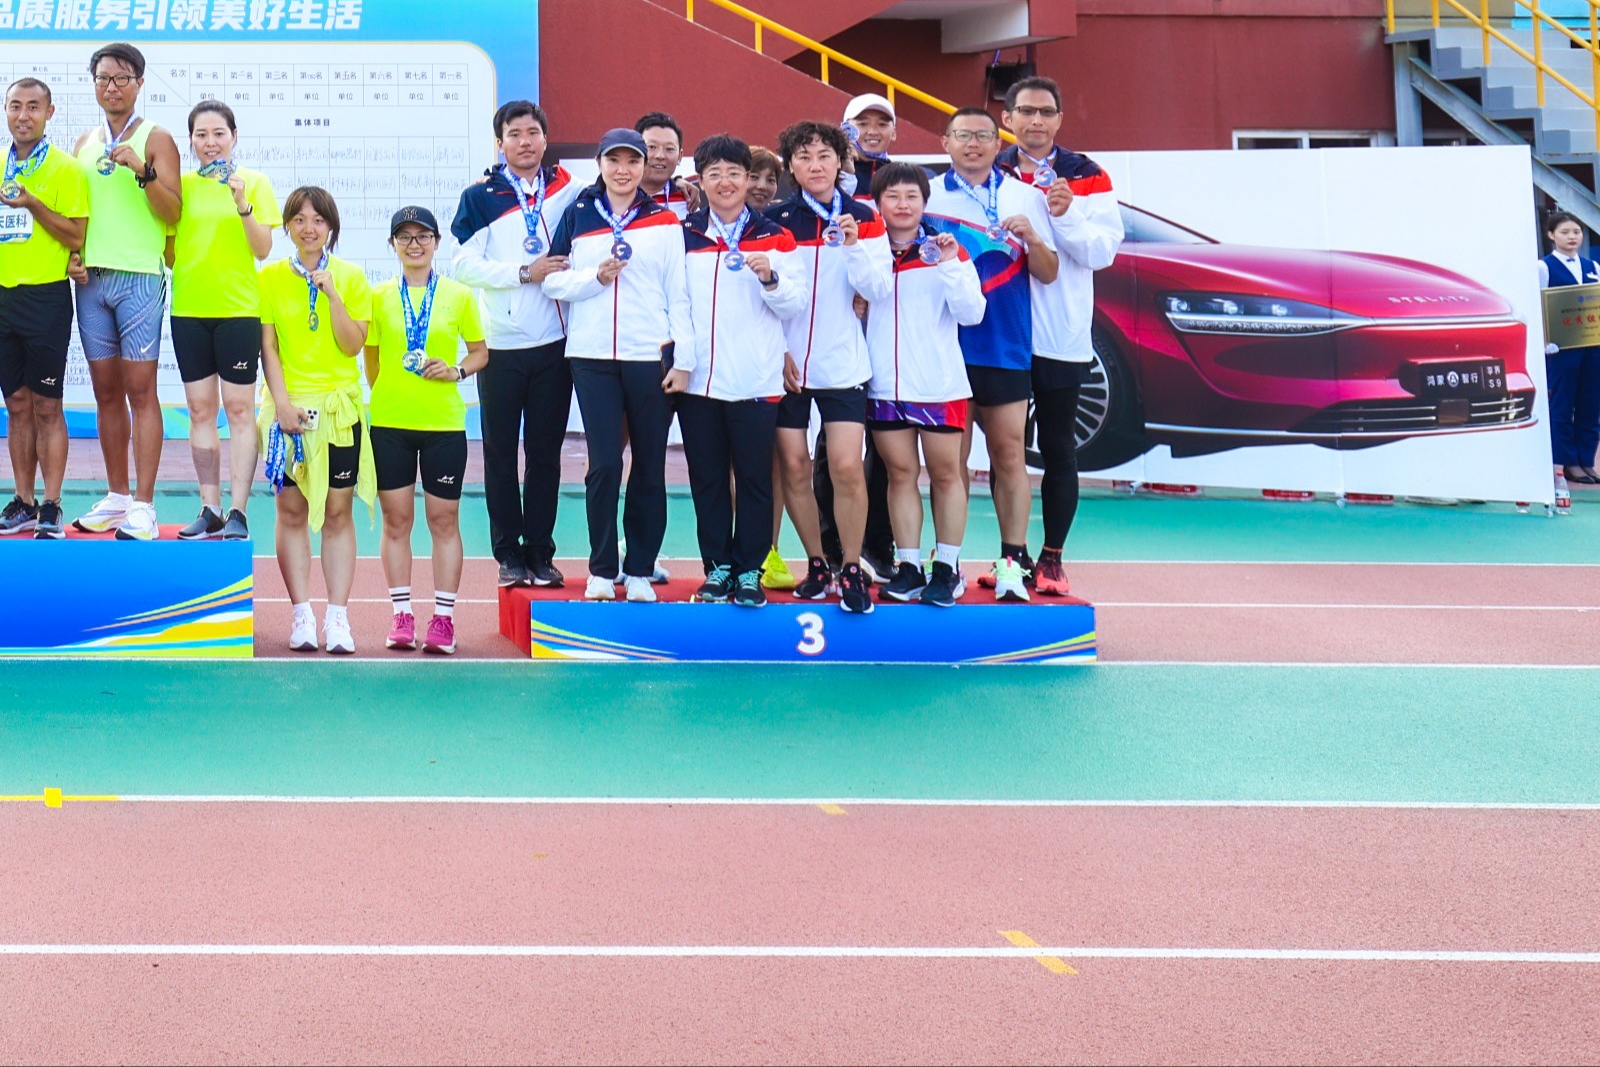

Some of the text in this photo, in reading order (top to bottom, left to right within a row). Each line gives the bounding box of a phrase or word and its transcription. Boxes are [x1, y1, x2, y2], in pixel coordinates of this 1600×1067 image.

[150, 94, 166, 102] 项目
[234, 92, 250, 101] 单位
[269, 92, 284, 101] 单位
[304, 92, 319, 101] 单位
[338, 92, 353, 101] 单位
[374, 92, 389, 101] 单位
[409, 92, 424, 101] 单位
[443, 92, 459, 101] 单位
[294, 118, 330, 127] 集体项目
[797, 611, 825, 655] 3
